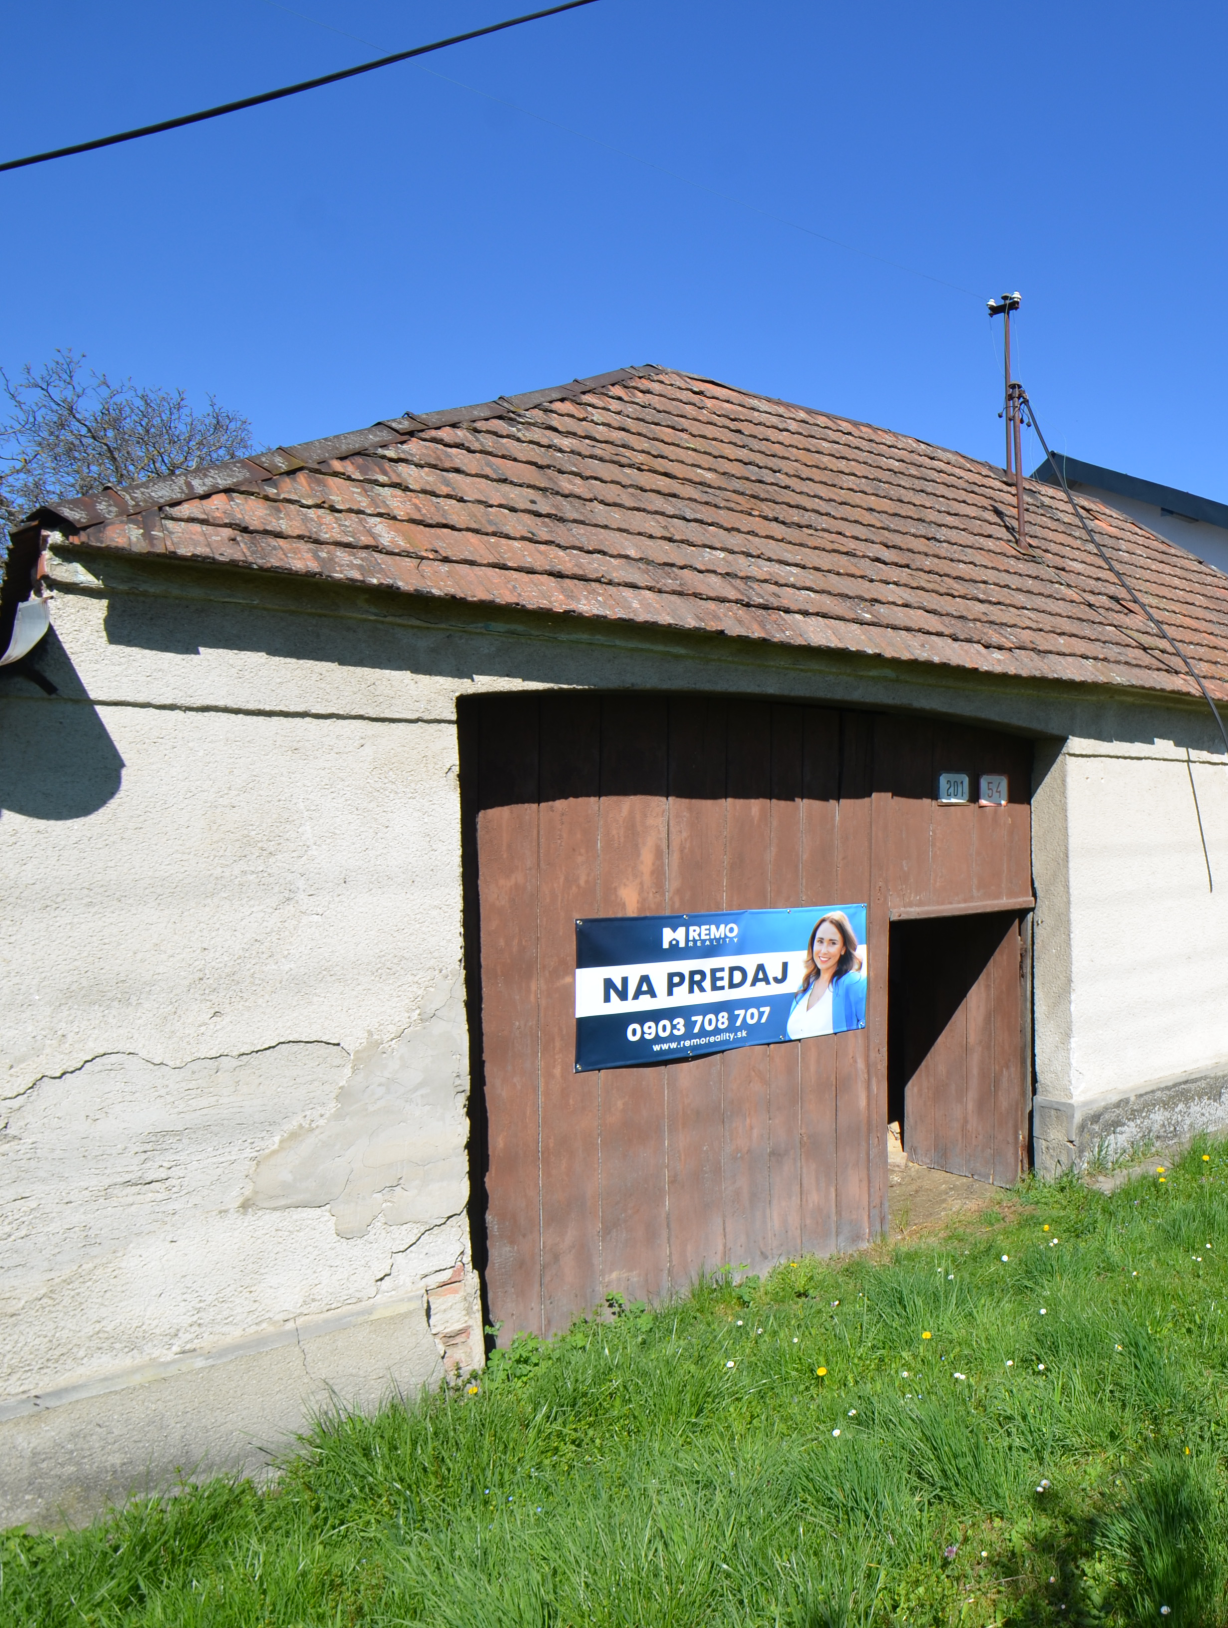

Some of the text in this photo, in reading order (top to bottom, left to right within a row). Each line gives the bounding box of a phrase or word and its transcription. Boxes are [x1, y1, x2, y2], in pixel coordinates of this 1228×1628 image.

[946, 780, 964, 797] 201
[986, 781, 1002, 799] 54
[688, 923, 738, 941] REMO
[688, 938, 738, 947] REALITY
[603, 961, 789, 1004] NA PREDAJ
[626, 1006, 771, 1042] 0903 708 707
[652, 1029, 748, 1052] www.remoreality.sk
